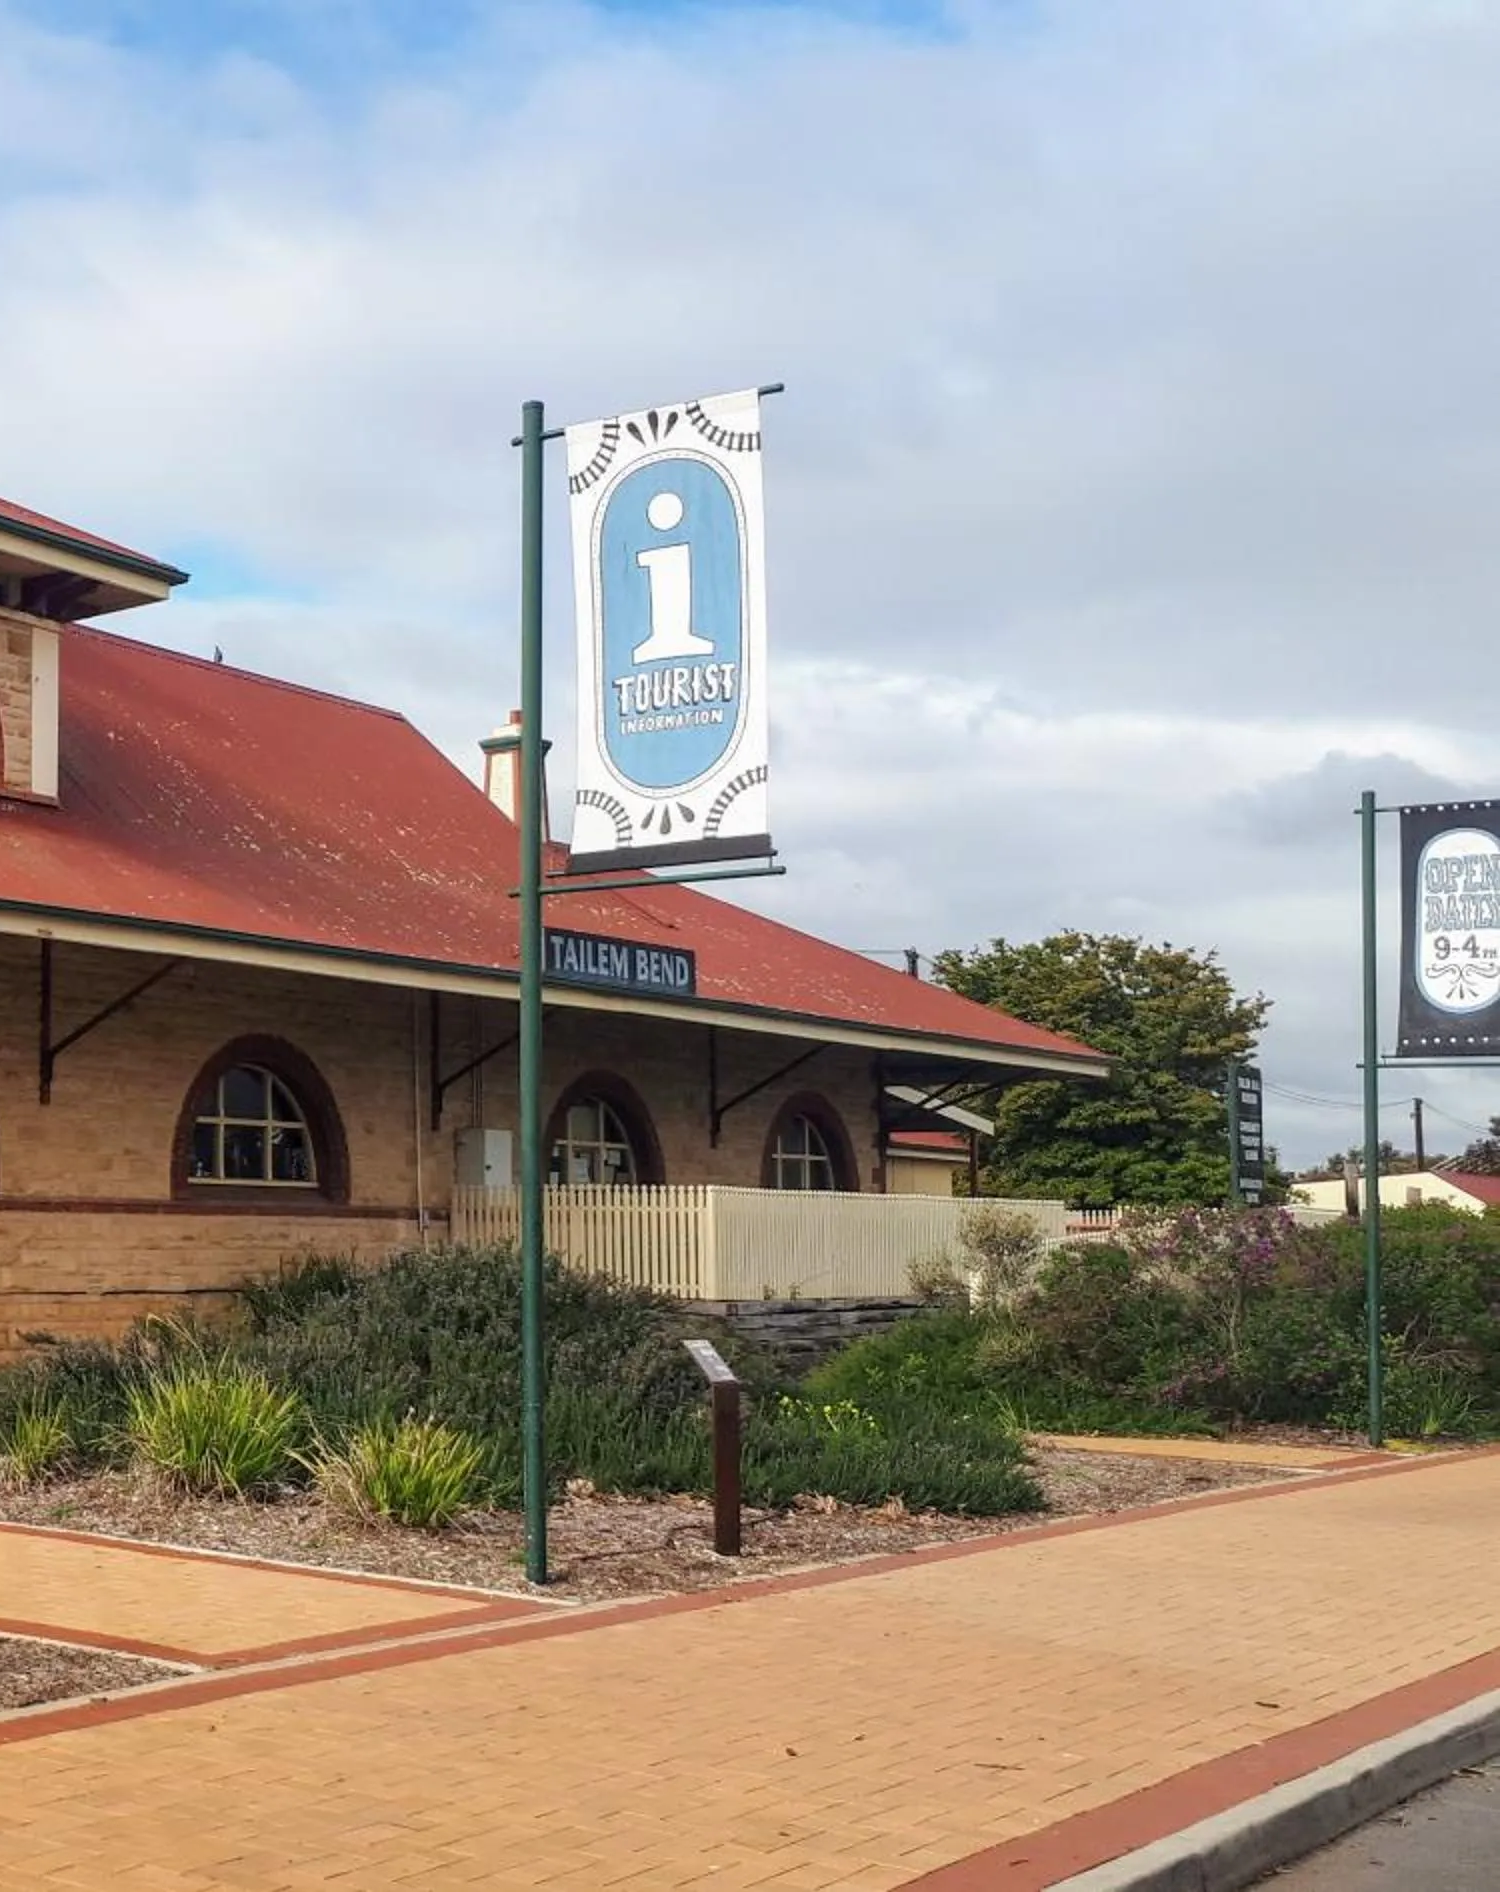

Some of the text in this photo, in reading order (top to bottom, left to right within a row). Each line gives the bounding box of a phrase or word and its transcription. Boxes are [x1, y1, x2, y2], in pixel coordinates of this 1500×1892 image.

[612, 663, 736, 716] TOURIST
[620, 709, 724, 735] INFORMATION
[1425, 853, 1500, 894] OPEN
[1424, 893, 1500, 932] DAILY
[550, 935, 689, 987] TAILEM BEND
[1434, 934, 1480, 960] 9-4
